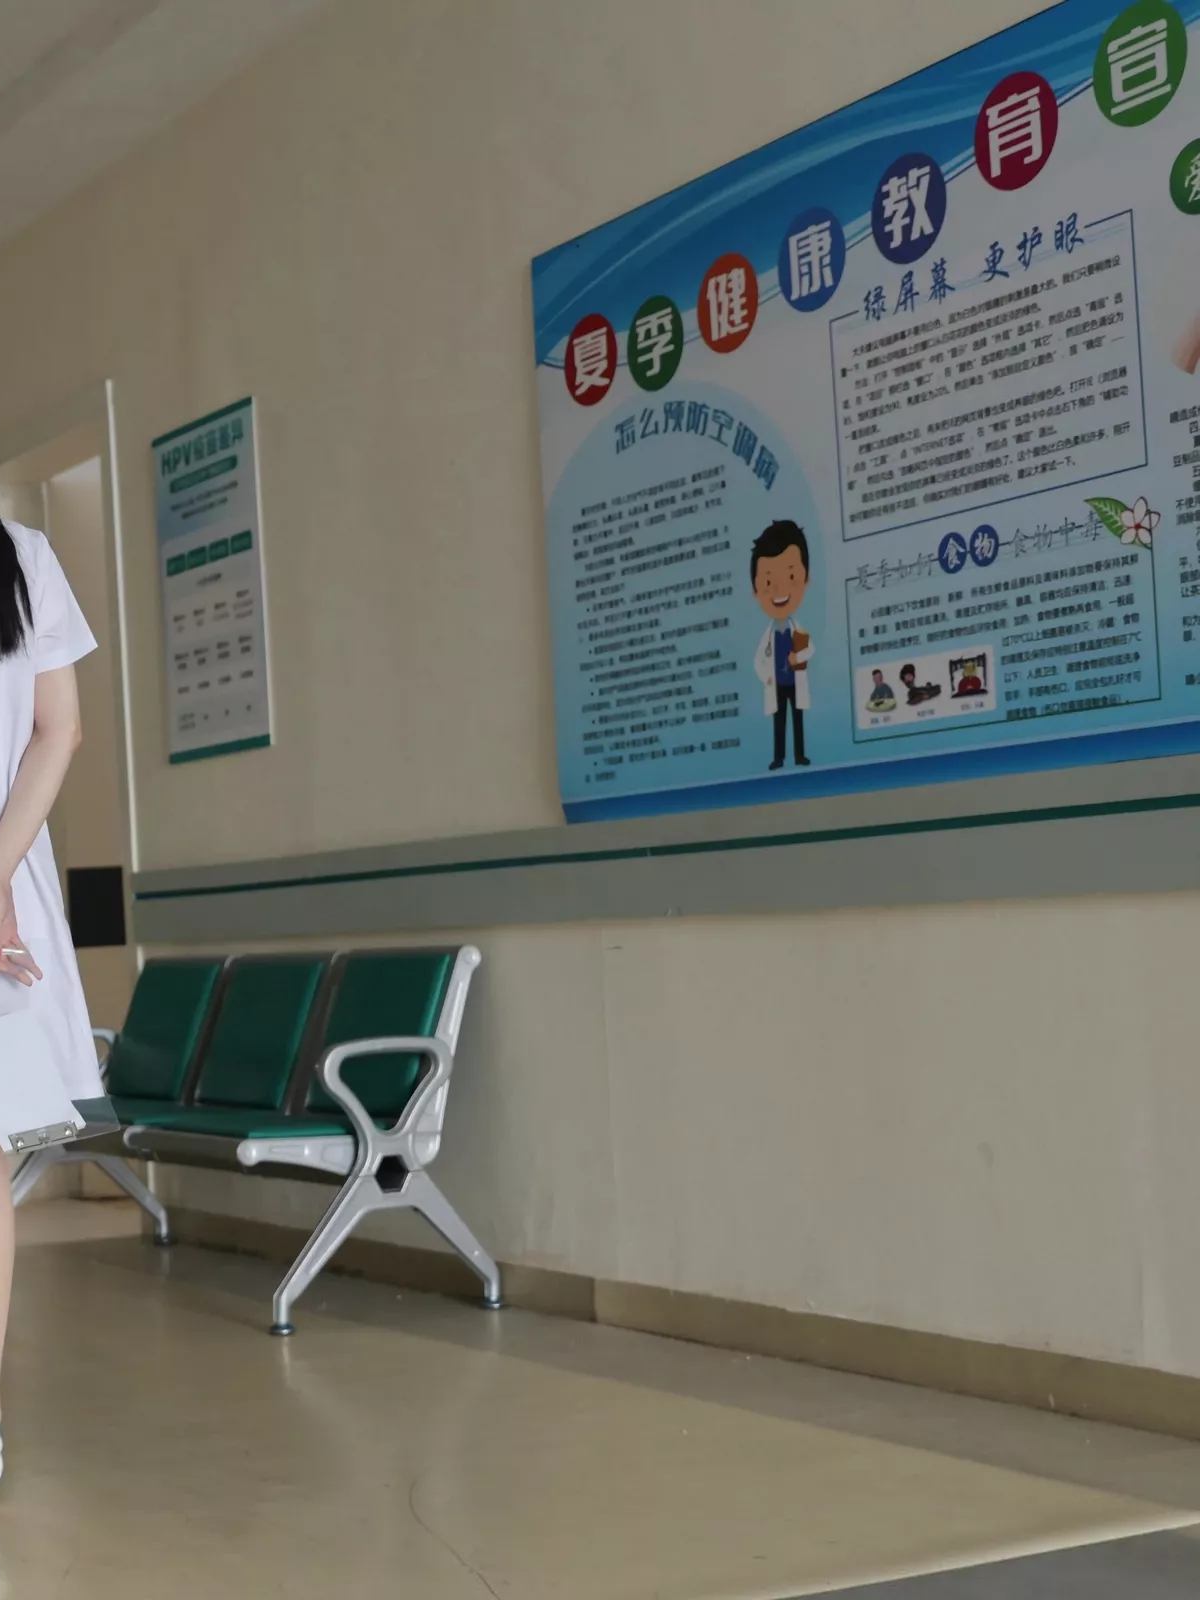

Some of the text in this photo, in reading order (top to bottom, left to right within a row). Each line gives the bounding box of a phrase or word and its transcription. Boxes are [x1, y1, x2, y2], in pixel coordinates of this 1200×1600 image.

[572, 17, 1172, 396] 夏季健康教育宣
[863, 212, 1084, 321] 绿屏幕 更护眼
[615, 400, 780, 492] 怎么预防空调病
